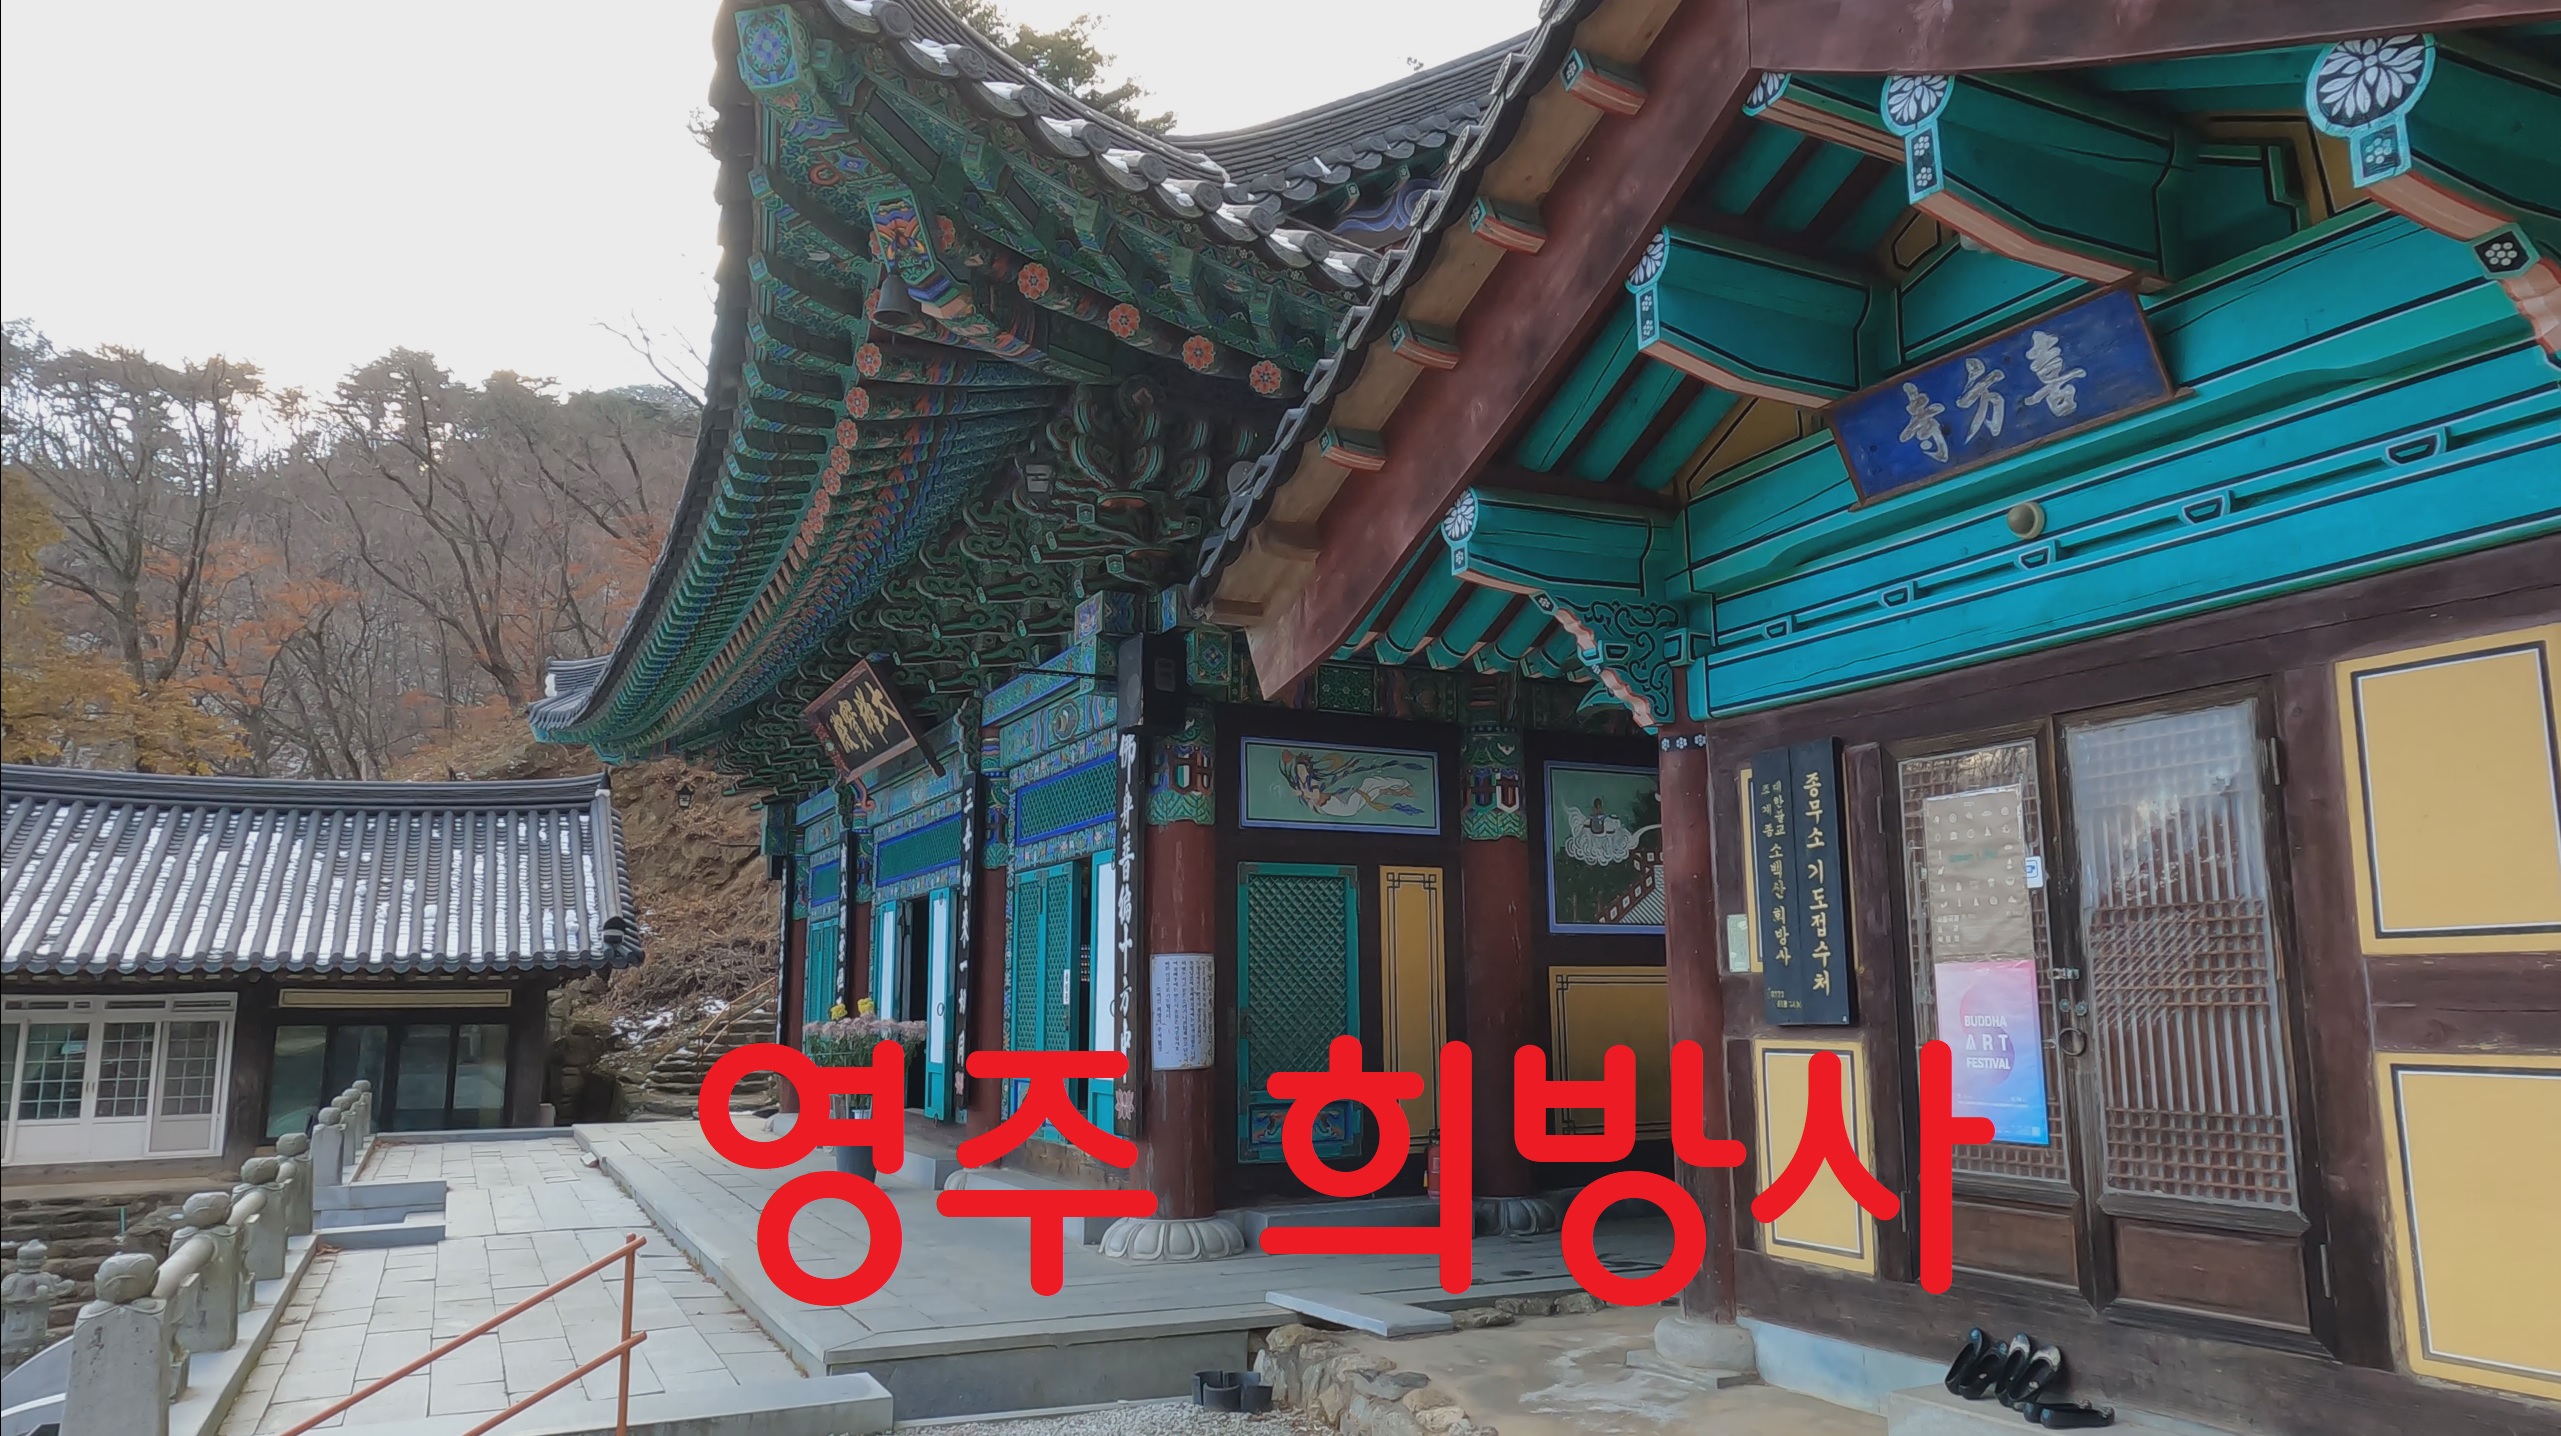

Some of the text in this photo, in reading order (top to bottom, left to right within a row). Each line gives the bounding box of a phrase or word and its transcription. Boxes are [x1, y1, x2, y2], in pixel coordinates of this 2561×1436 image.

[1899, 330, 2088, 463] 喜方寺
[1772, 779, 1786, 836] 대한불교
[1768, 842, 1787, 900] 소백산
[1802, 771, 1831, 997] 종무소 기도접수처
[1772, 905, 1791, 968] 희방사
[1964, 1015, 2008, 1028] BUDDHA
[1965, 1034, 2009, 1051] ART
[1966, 1057, 2011, 1070] FESTIVAL
